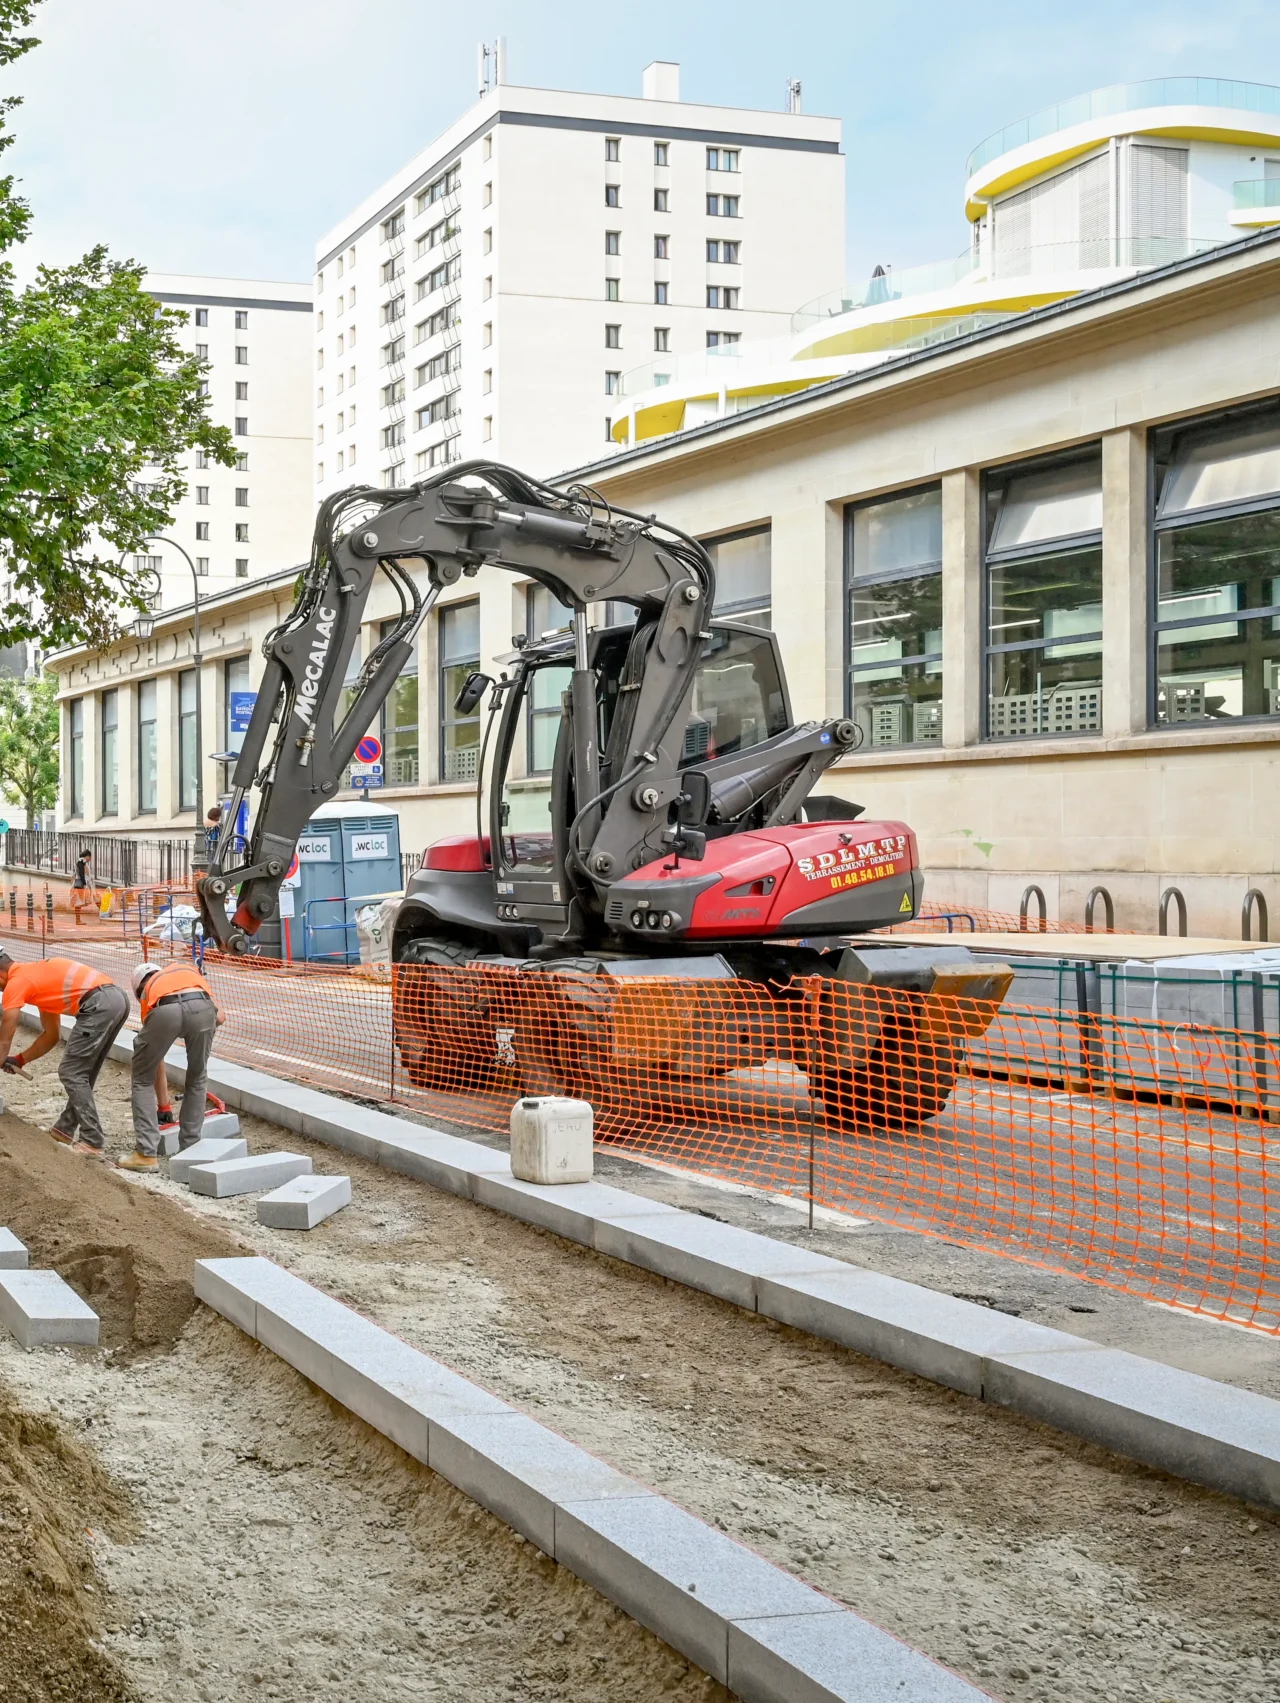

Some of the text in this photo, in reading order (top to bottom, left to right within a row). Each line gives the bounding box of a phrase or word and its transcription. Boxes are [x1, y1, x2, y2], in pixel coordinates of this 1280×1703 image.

[805, 860, 866, 881] TERRASSEMENT
[870, 851, 904, 866] DEMOLITION
[831, 863, 895, 888] 01.48.54.18.18
